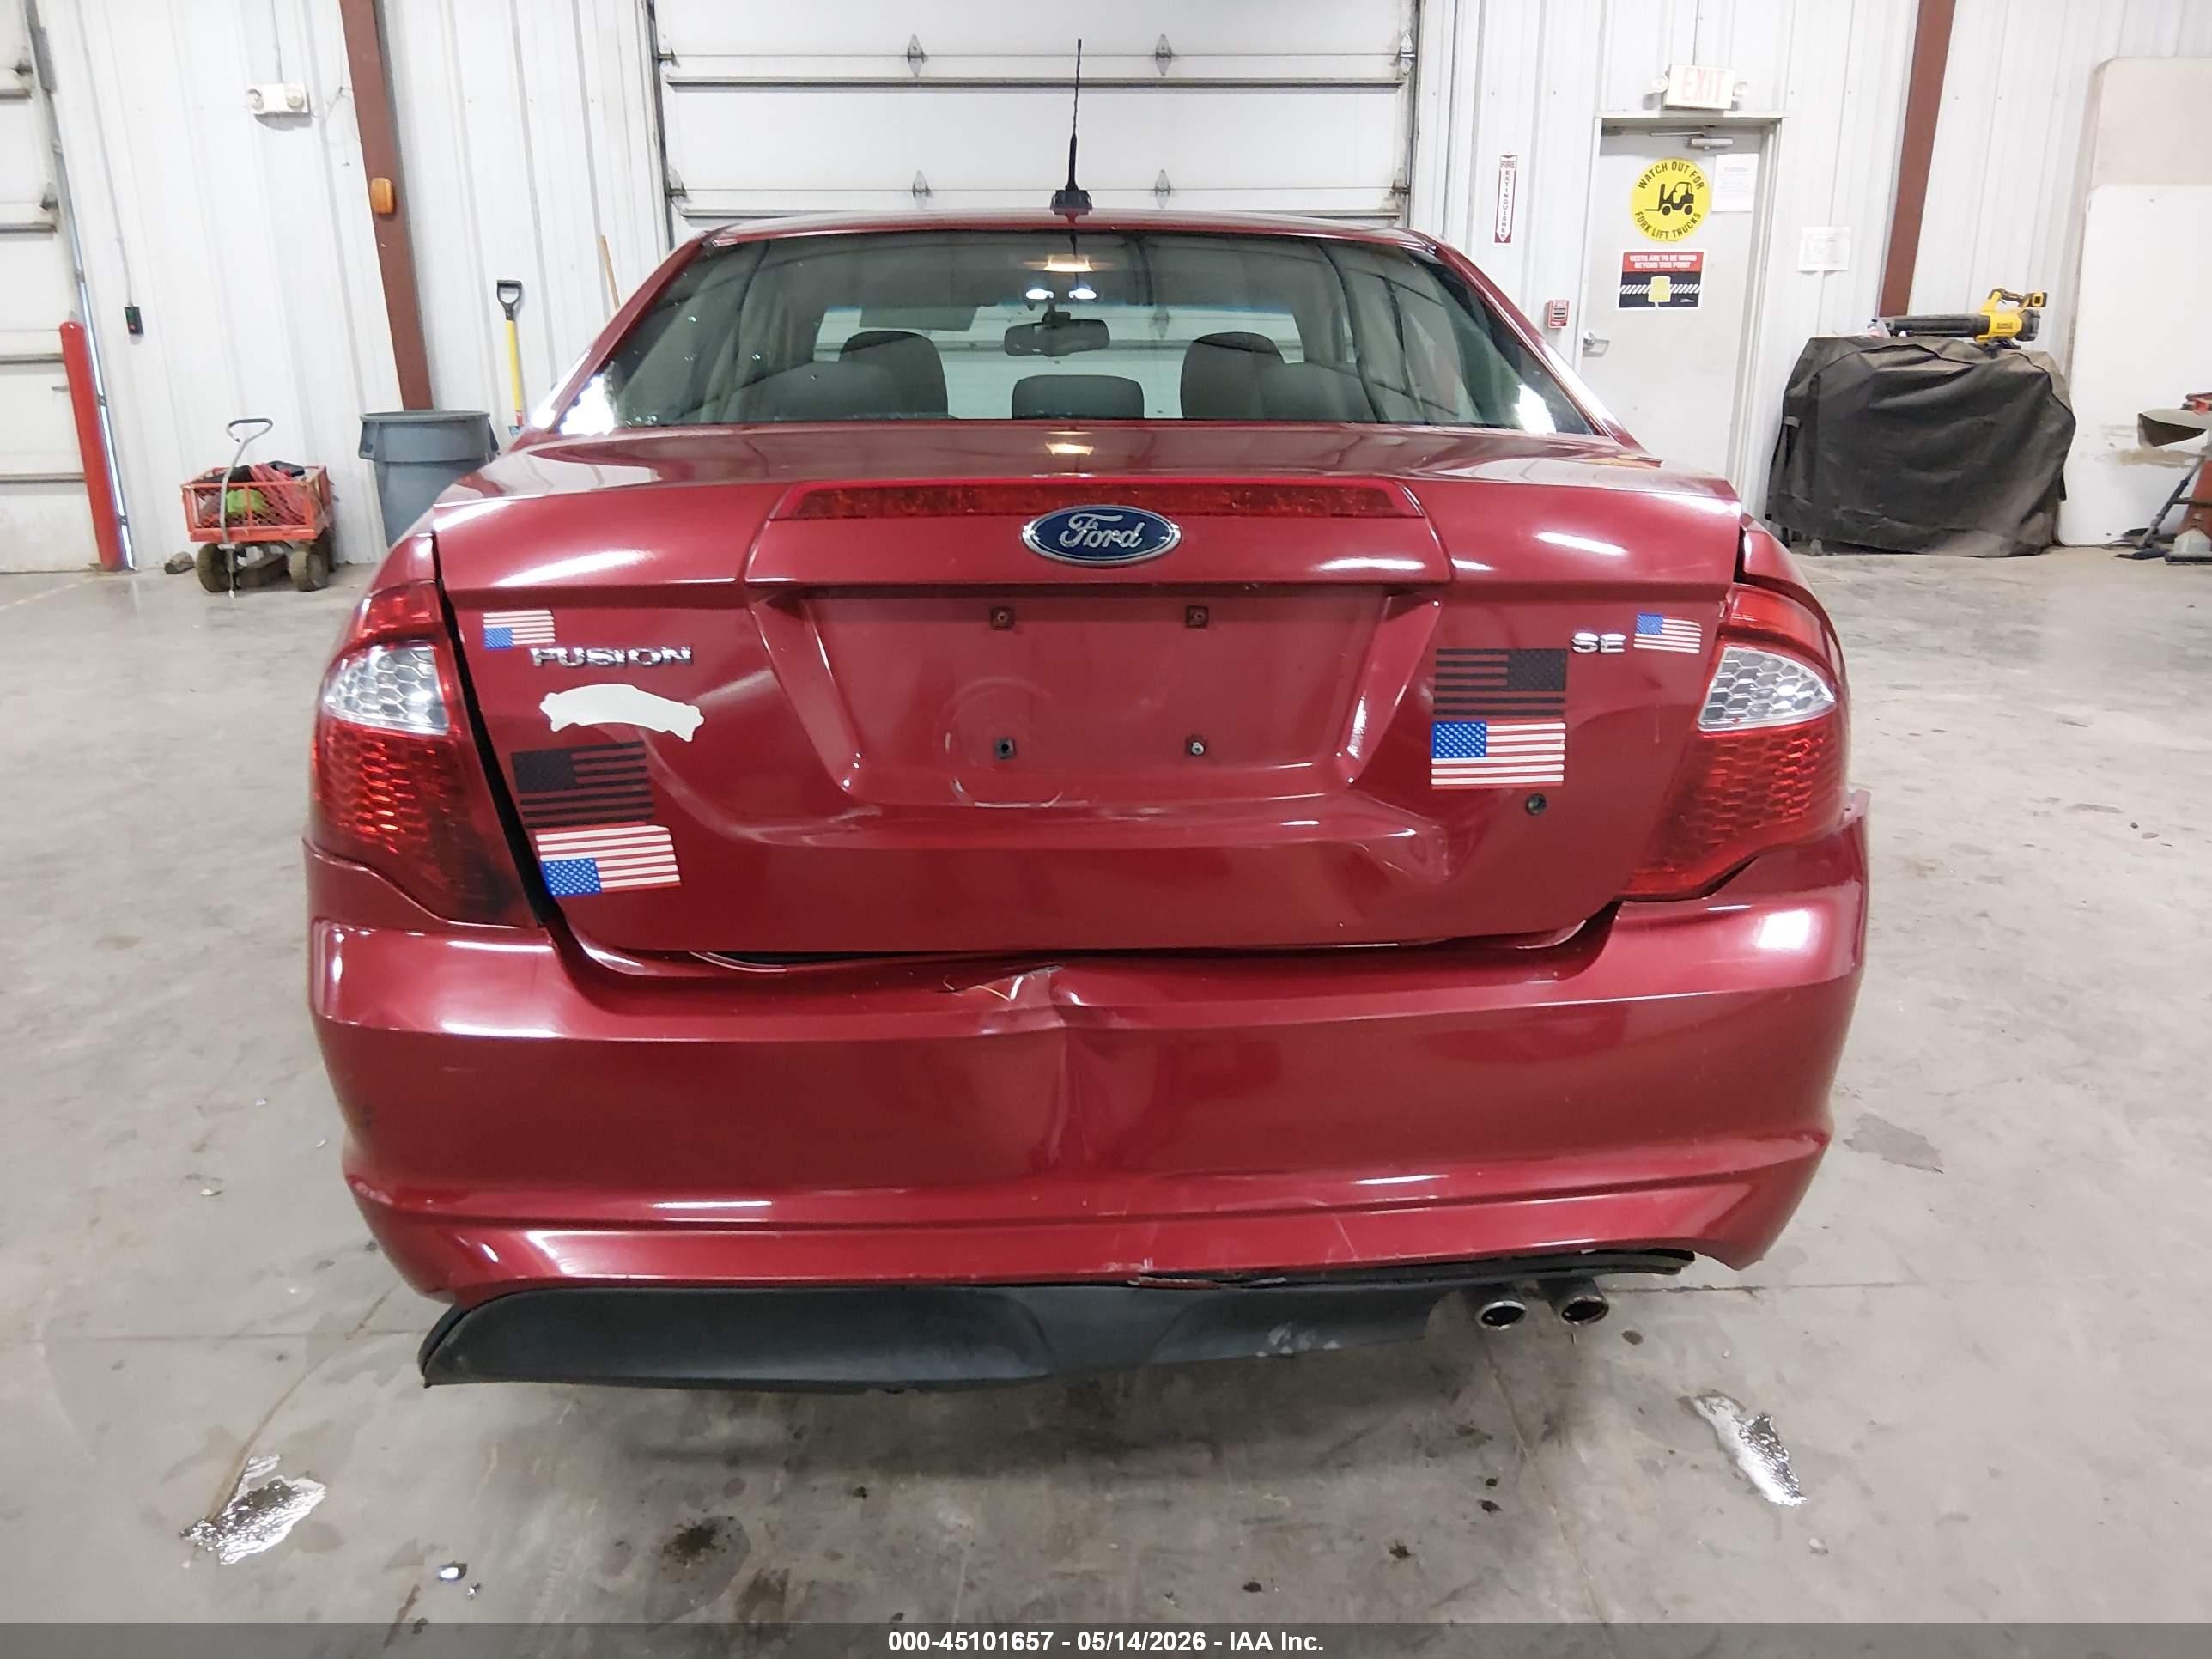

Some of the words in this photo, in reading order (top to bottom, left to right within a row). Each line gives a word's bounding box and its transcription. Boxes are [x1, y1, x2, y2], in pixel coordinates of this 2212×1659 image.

[1681, 67, 1726, 103] EXIT
[1638, 161, 1668, 190] WATCH
[1671, 161, 1691, 174] OUT
[1689, 170, 1705, 190] FOR
[1634, 210, 1652, 233] FORK
[1651, 228, 1669, 240] LIFT
[1672, 213, 1702, 238] TRUCKS
[1060, 514, 1146, 548] Ford
[530, 647, 693, 667] FUSION
[1571, 632, 1626, 653] SE
